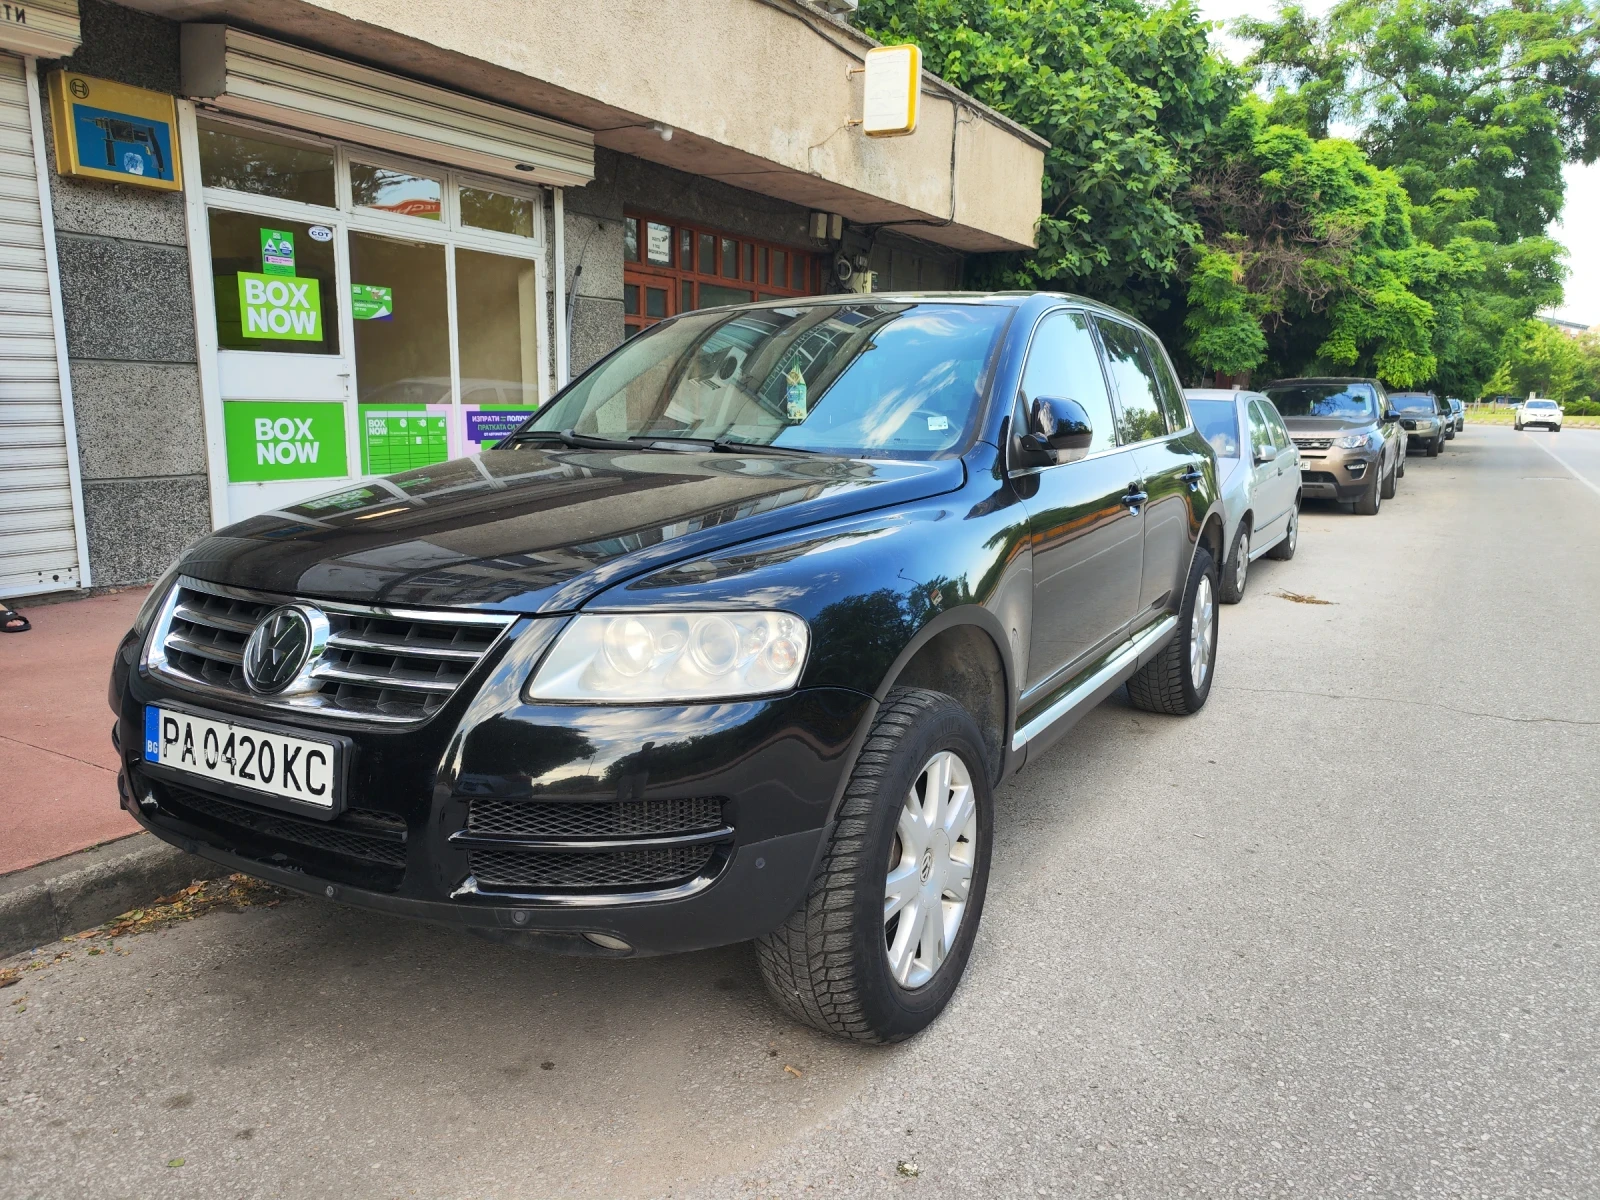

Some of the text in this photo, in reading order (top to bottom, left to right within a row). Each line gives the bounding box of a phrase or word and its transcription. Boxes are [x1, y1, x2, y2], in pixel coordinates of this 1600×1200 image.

[245, 279, 310, 308] BOX
[247, 307, 317, 334] NOW
[255, 417, 314, 440] BOX
[368, 419, 386, 428] BOX
[369, 427, 388, 435] NOW
[256, 441, 319, 465] NOW
[147, 740, 158, 754] BG
